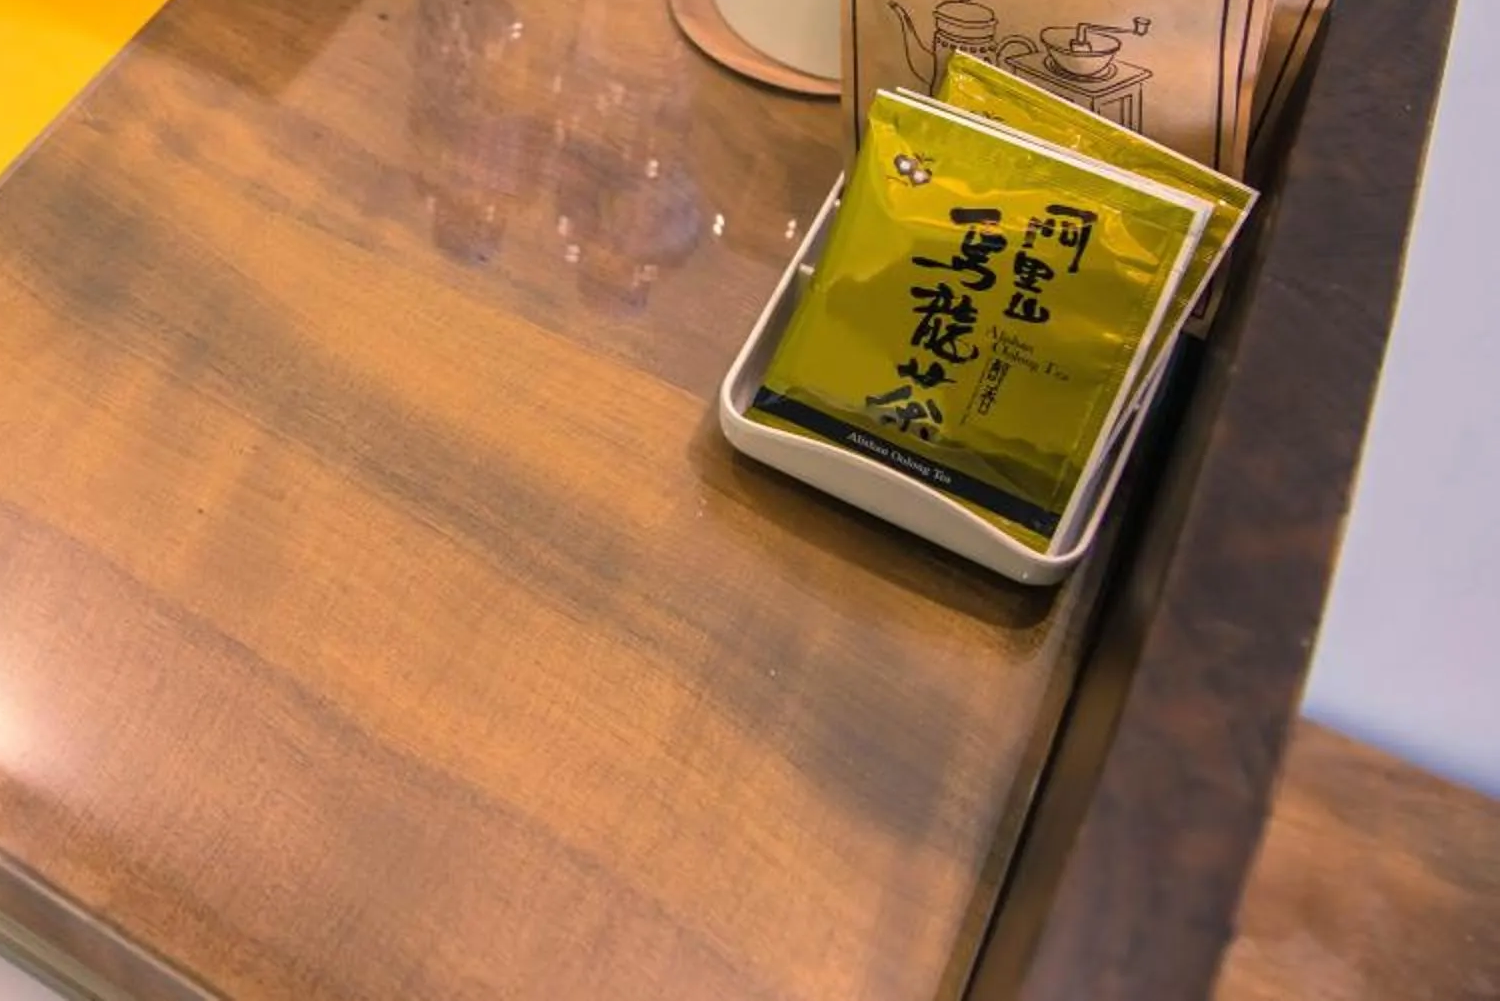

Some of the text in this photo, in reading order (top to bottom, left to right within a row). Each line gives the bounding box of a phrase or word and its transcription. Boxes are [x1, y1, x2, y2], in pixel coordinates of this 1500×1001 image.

[1003, 203, 1098, 324] 阿里山
[866, 207, 1008, 442] 烏龍茶
[890, 450, 931, 476] Oolong
[934, 468, 953, 485] Tea
